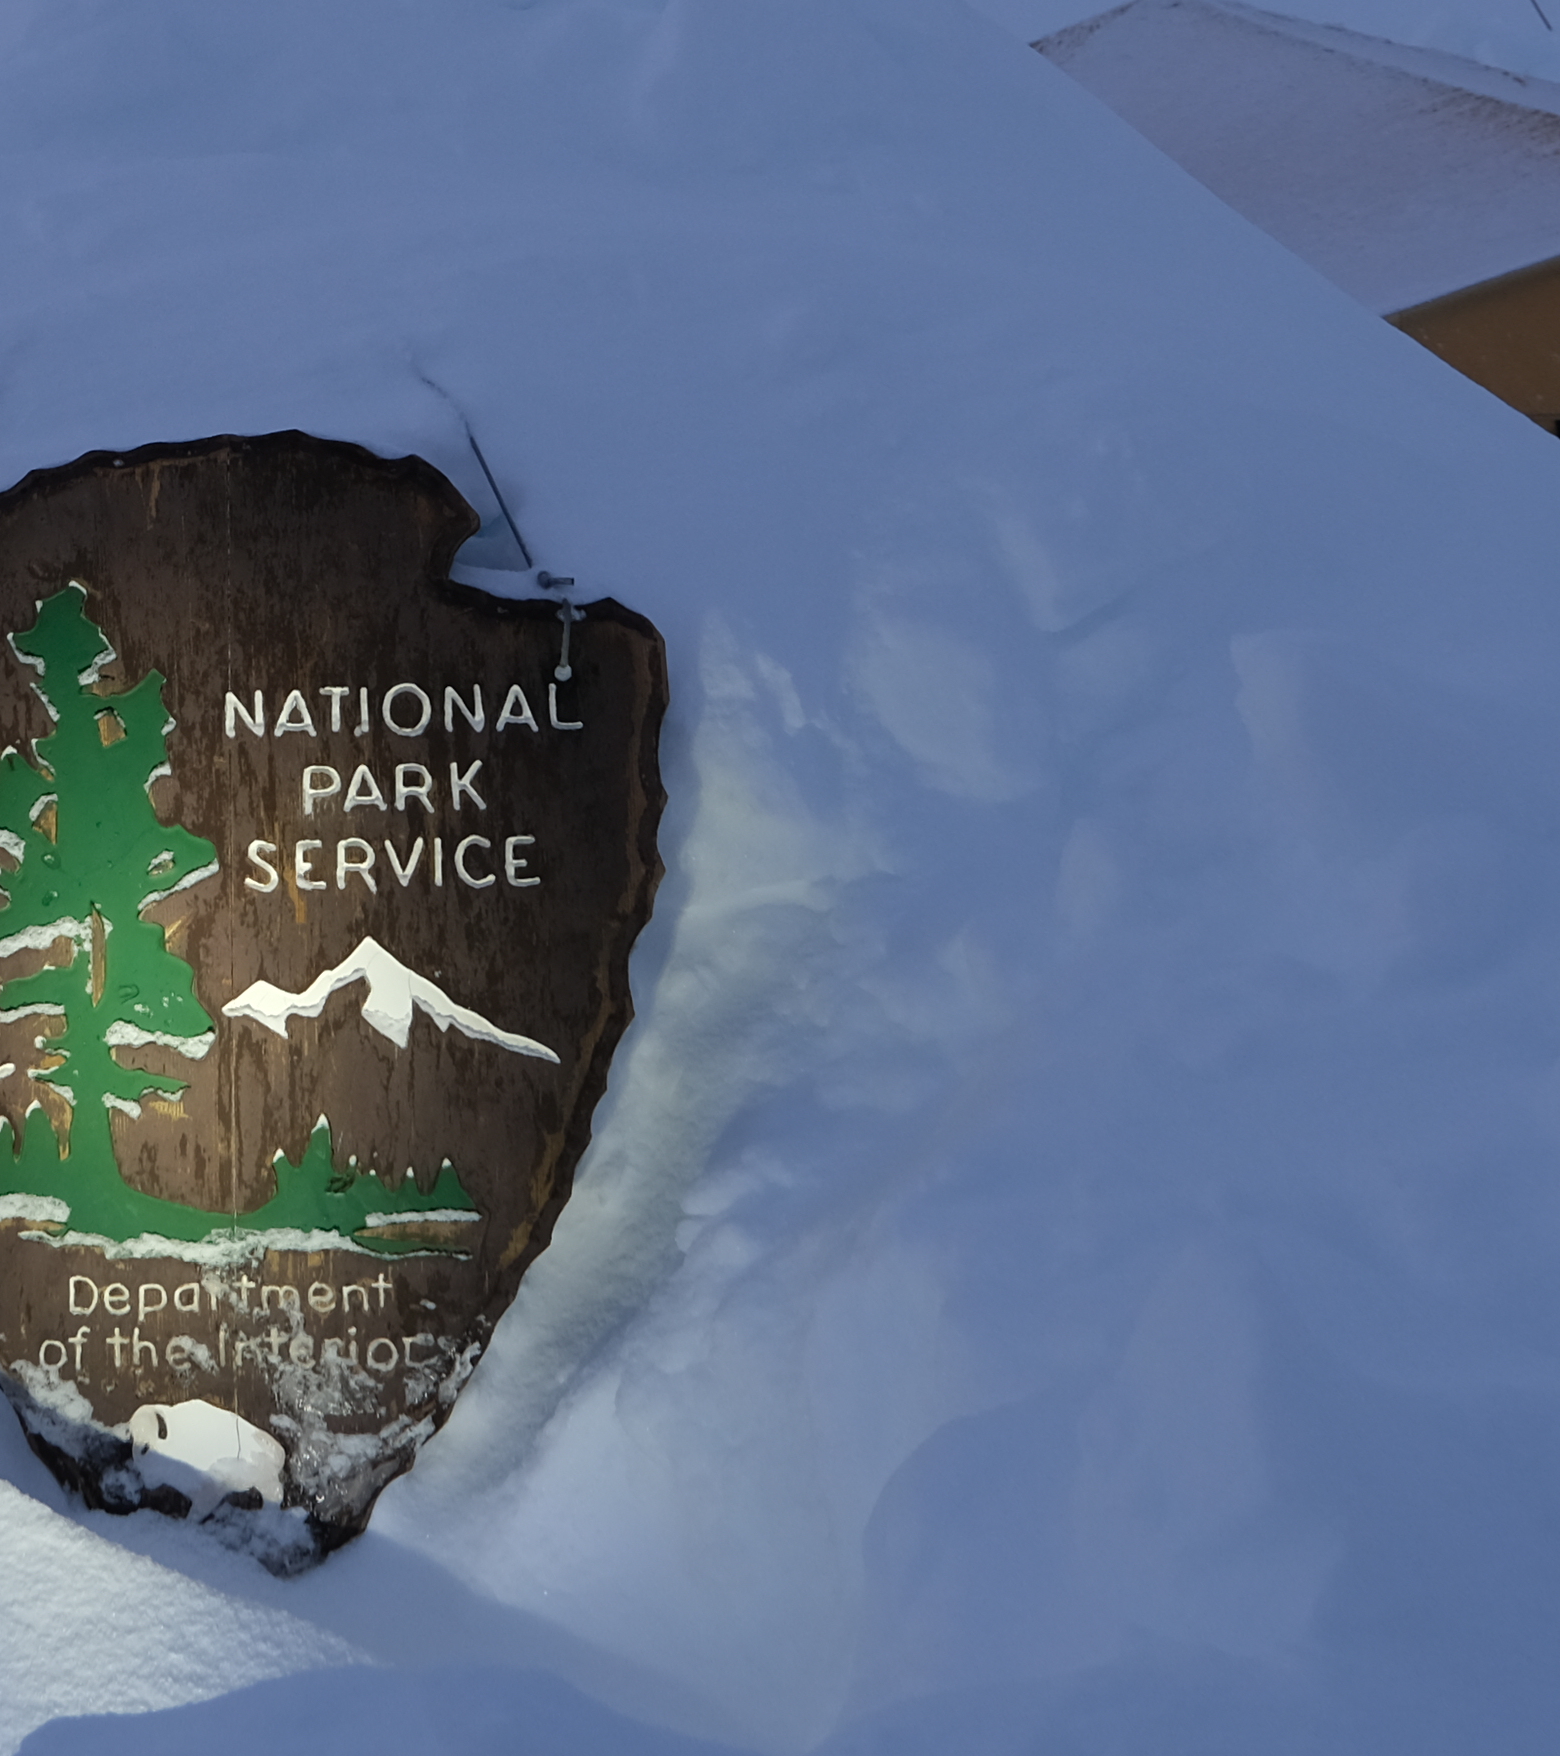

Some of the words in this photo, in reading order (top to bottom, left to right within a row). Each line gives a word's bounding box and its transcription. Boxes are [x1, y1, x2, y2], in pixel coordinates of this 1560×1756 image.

[224, 682, 584, 738] NATIONAL
[302, 759, 487, 815] PARK
[244, 834, 541, 894] SERVICE
[68, 1273, 393, 1322] Department
[38, 1326, 91, 1370] of
[105, 1327, 193, 1370] the
[218, 1322, 436, 1372] Interior
